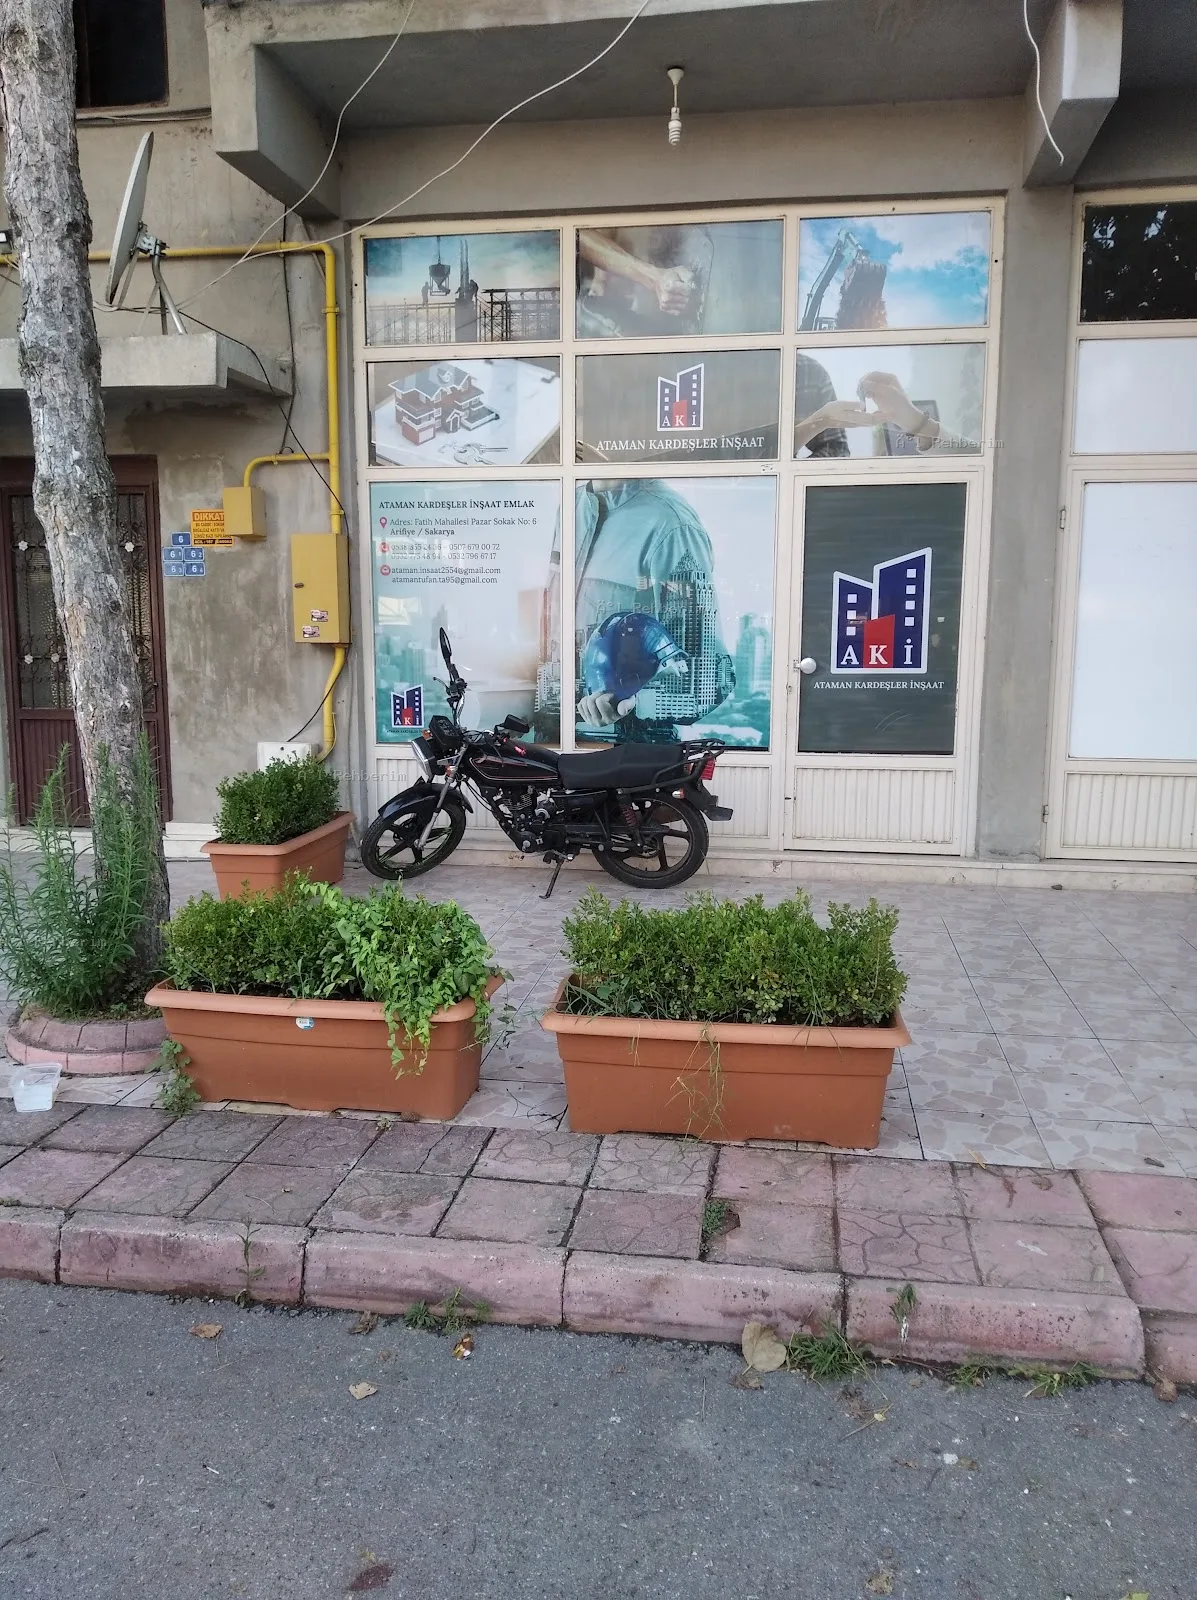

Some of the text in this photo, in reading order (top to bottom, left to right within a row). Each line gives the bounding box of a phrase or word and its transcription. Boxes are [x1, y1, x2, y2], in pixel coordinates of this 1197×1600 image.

[597, 435, 765, 451] ATAMAN KARDEŞLER İNŞAAT
[379, 499, 535, 510] ATAMAN KARDEŞLER İNŞAAT EMLAK
[390, 518, 413, 526] Adres:
[414, 518, 433, 526] Fatih
[435, 518, 469, 526] Mahallesi
[471, 518, 492, 526] Pazar
[493, 518, 516, 526] Sokak
[390, 527, 455, 538] Arifiye / Sakarya
[449, 543, 466, 551] 0507
[467, 543, 480, 551] 679
[481, 543, 491, 551] 00
[492, 543, 500, 551] 72
[448, 552, 465, 560] 0532
[480, 552, 489, 560] 67
[490, 552, 497, 560] 17
[840, 638, 914, 665] AKİ
[855, 681, 908, 690] KARDEŞLER
[910, 680, 945, 690] İNŞAAT
